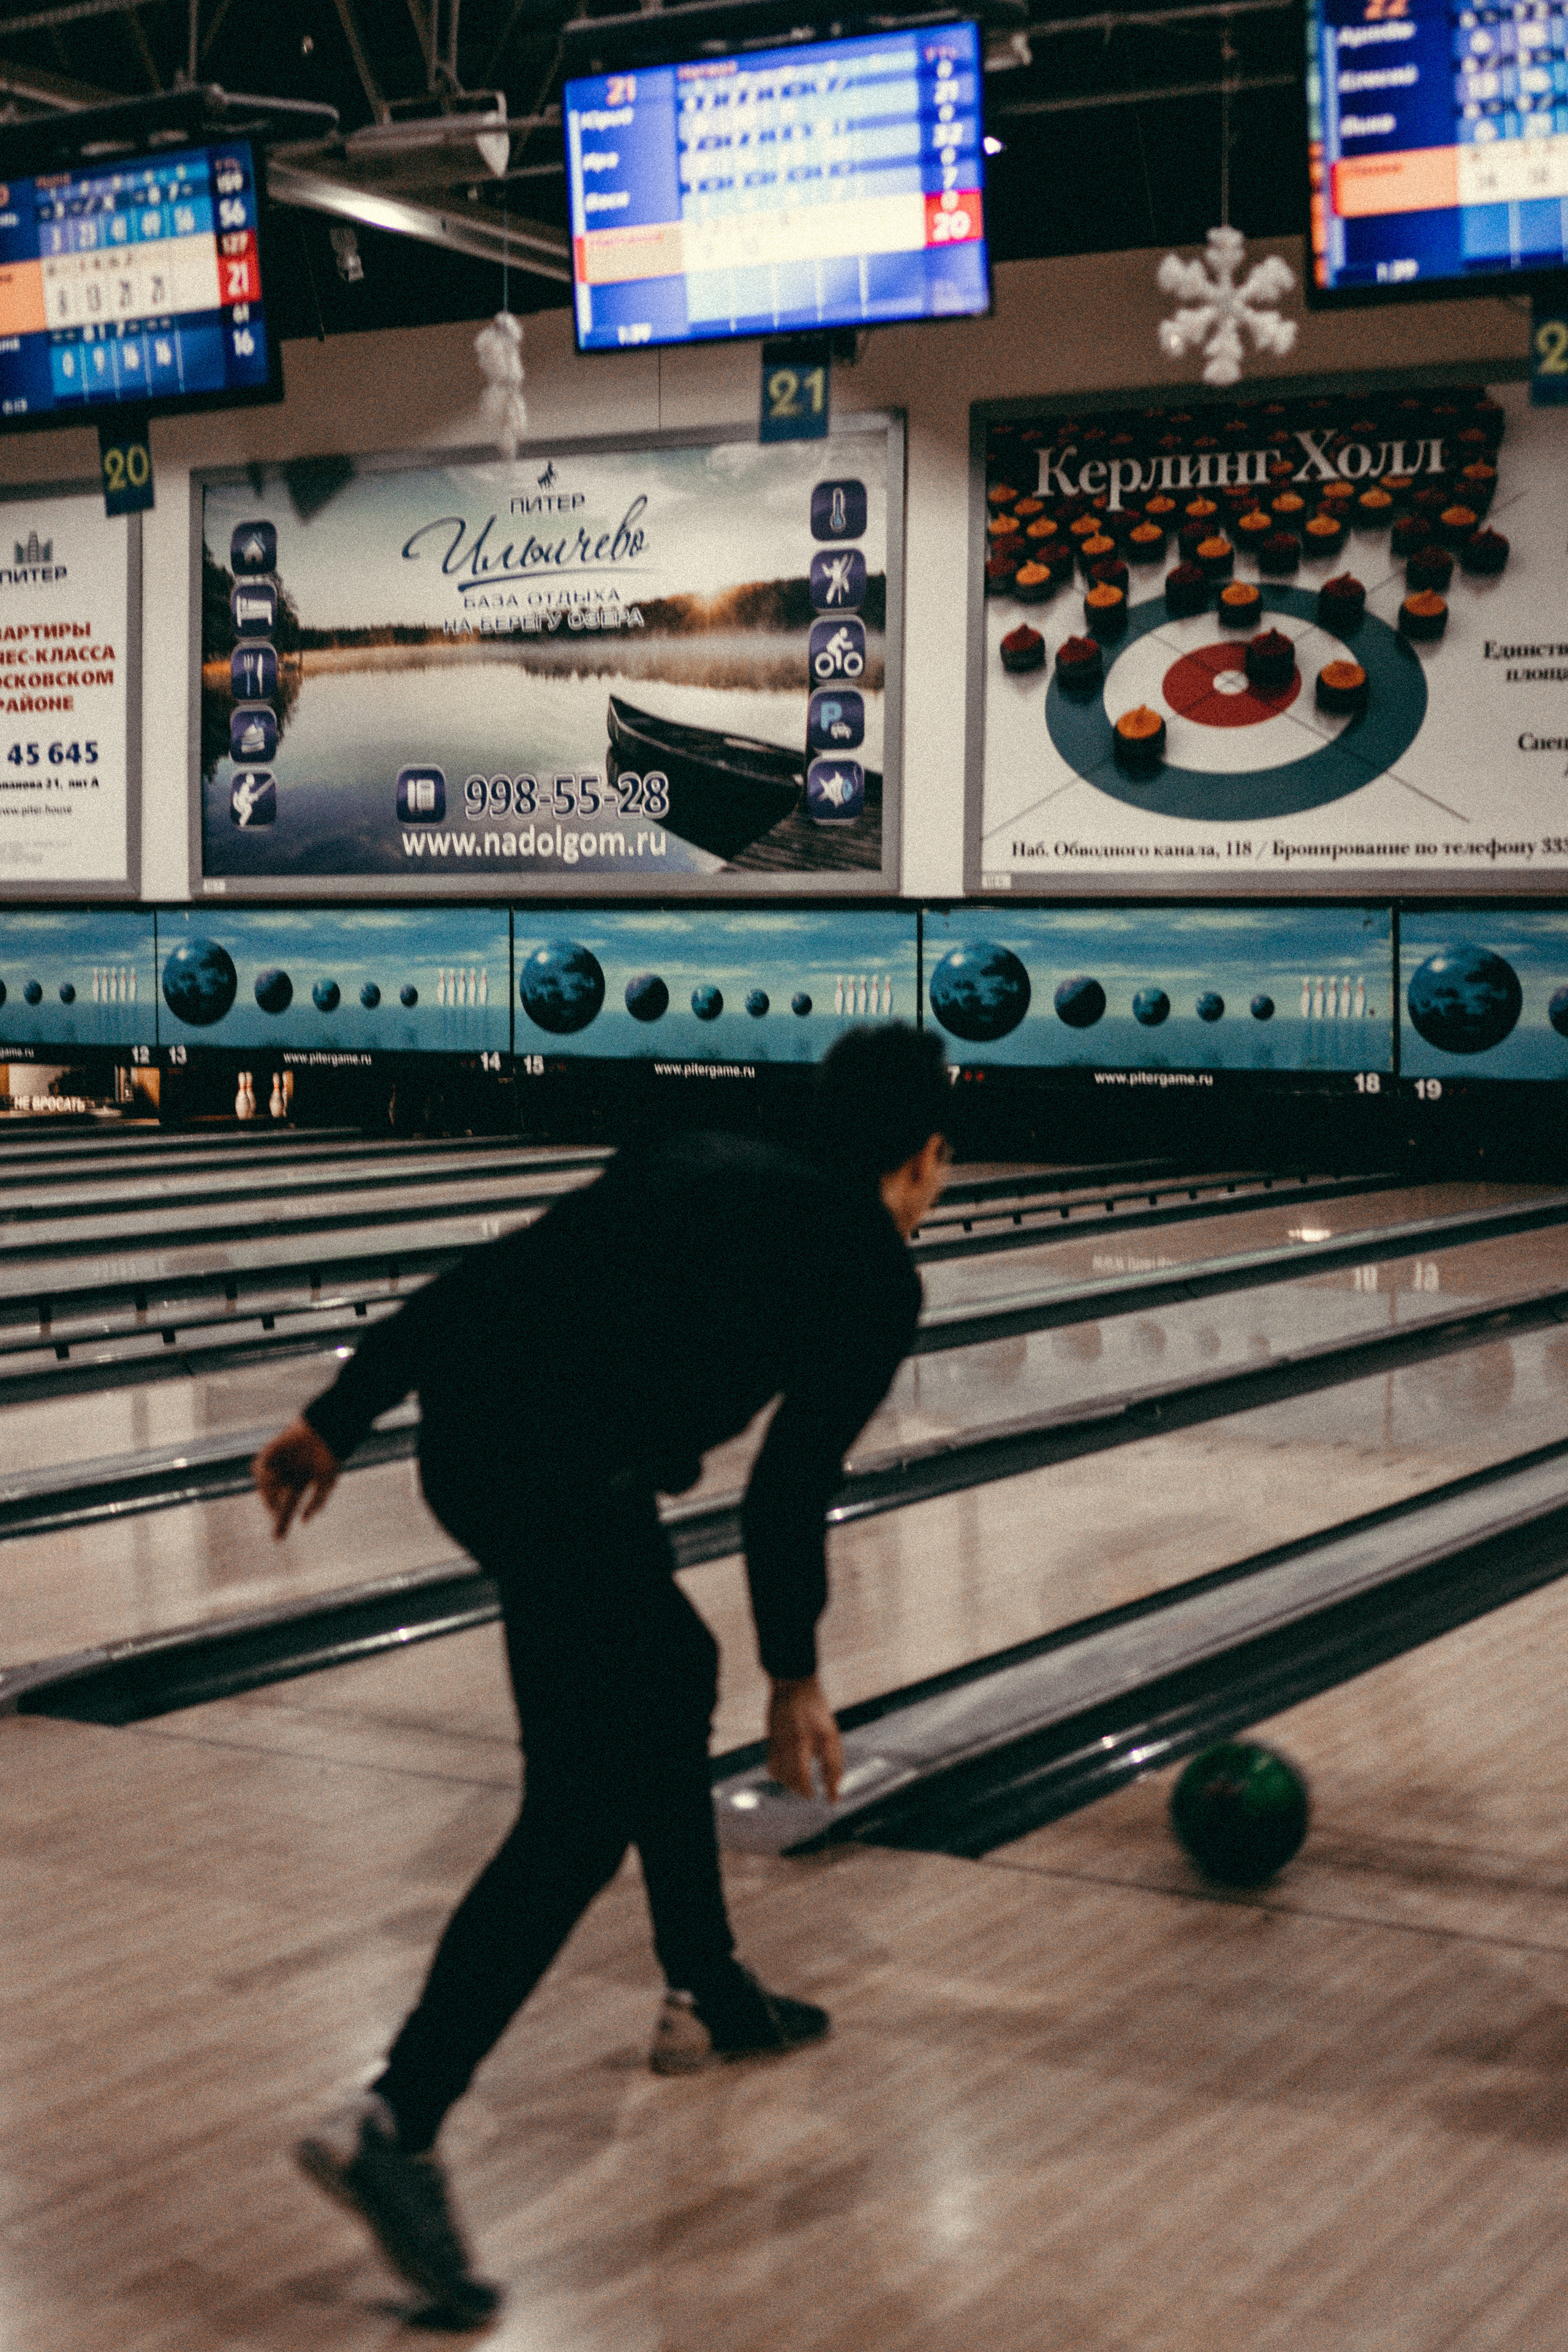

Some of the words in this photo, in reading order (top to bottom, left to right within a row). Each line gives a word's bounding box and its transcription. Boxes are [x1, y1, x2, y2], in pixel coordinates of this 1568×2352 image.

[606, 75, 636, 106] 21
[932, 210, 971, 242] 20
[227, 261, 249, 296] 21
[233, 328, 255, 356] 16
[768, 367, 824, 417] 21
[104, 445, 149, 490] 20
[1031, 445, 1281, 512] Керлинг
[1291, 429, 1445, 482] Холл
[510, 492, 585, 515] ПИТЕР
[464, 592, 519, 609] БАЗА
[527, 587, 620, 608] ОТДЫХА
[0, 622, 91, 641] АРТИРЫ
[443, 617, 473, 635] НА
[480, 611, 562, 634] БЕРЕГУ
[567, 607, 644, 631] ОЗЕРА
[0, 669, 114, 688] СКОВСКОМ
[7, 743, 40, 765] 45
[48, 741, 99, 764] 645
[464, 772, 669, 820] 998-55-28
[402, 824, 667, 864] www.nadolgom.ru
[1012, 841, 1049, 858] Наб.
[1054, 840, 1149, 859] Обводного
[1154, 844, 1220, 859] канала,
[1227, 840, 1252, 856] 118
[1273, 840, 1409, 861] Бронирование
[1415, 843, 1438, 855] по
[1442, 837, 1534, 861] телефону
[132, 1045, 149, 1064] 12
[169, 1045, 187, 1065] 13
[284, 1052, 372, 1068] www.pitergame.ru
[481, 1051, 501, 1071] 14
[524, 1055, 544, 1076] 15
[654, 1062, 755, 1079] www.pitergame.ru
[947, 1065, 960, 1086] 7
[1094, 1071, 1213, 1088] www.pitergame.ru
[1354, 1072, 1381, 1094] 18
[1414, 1079, 1442, 1101] 19
